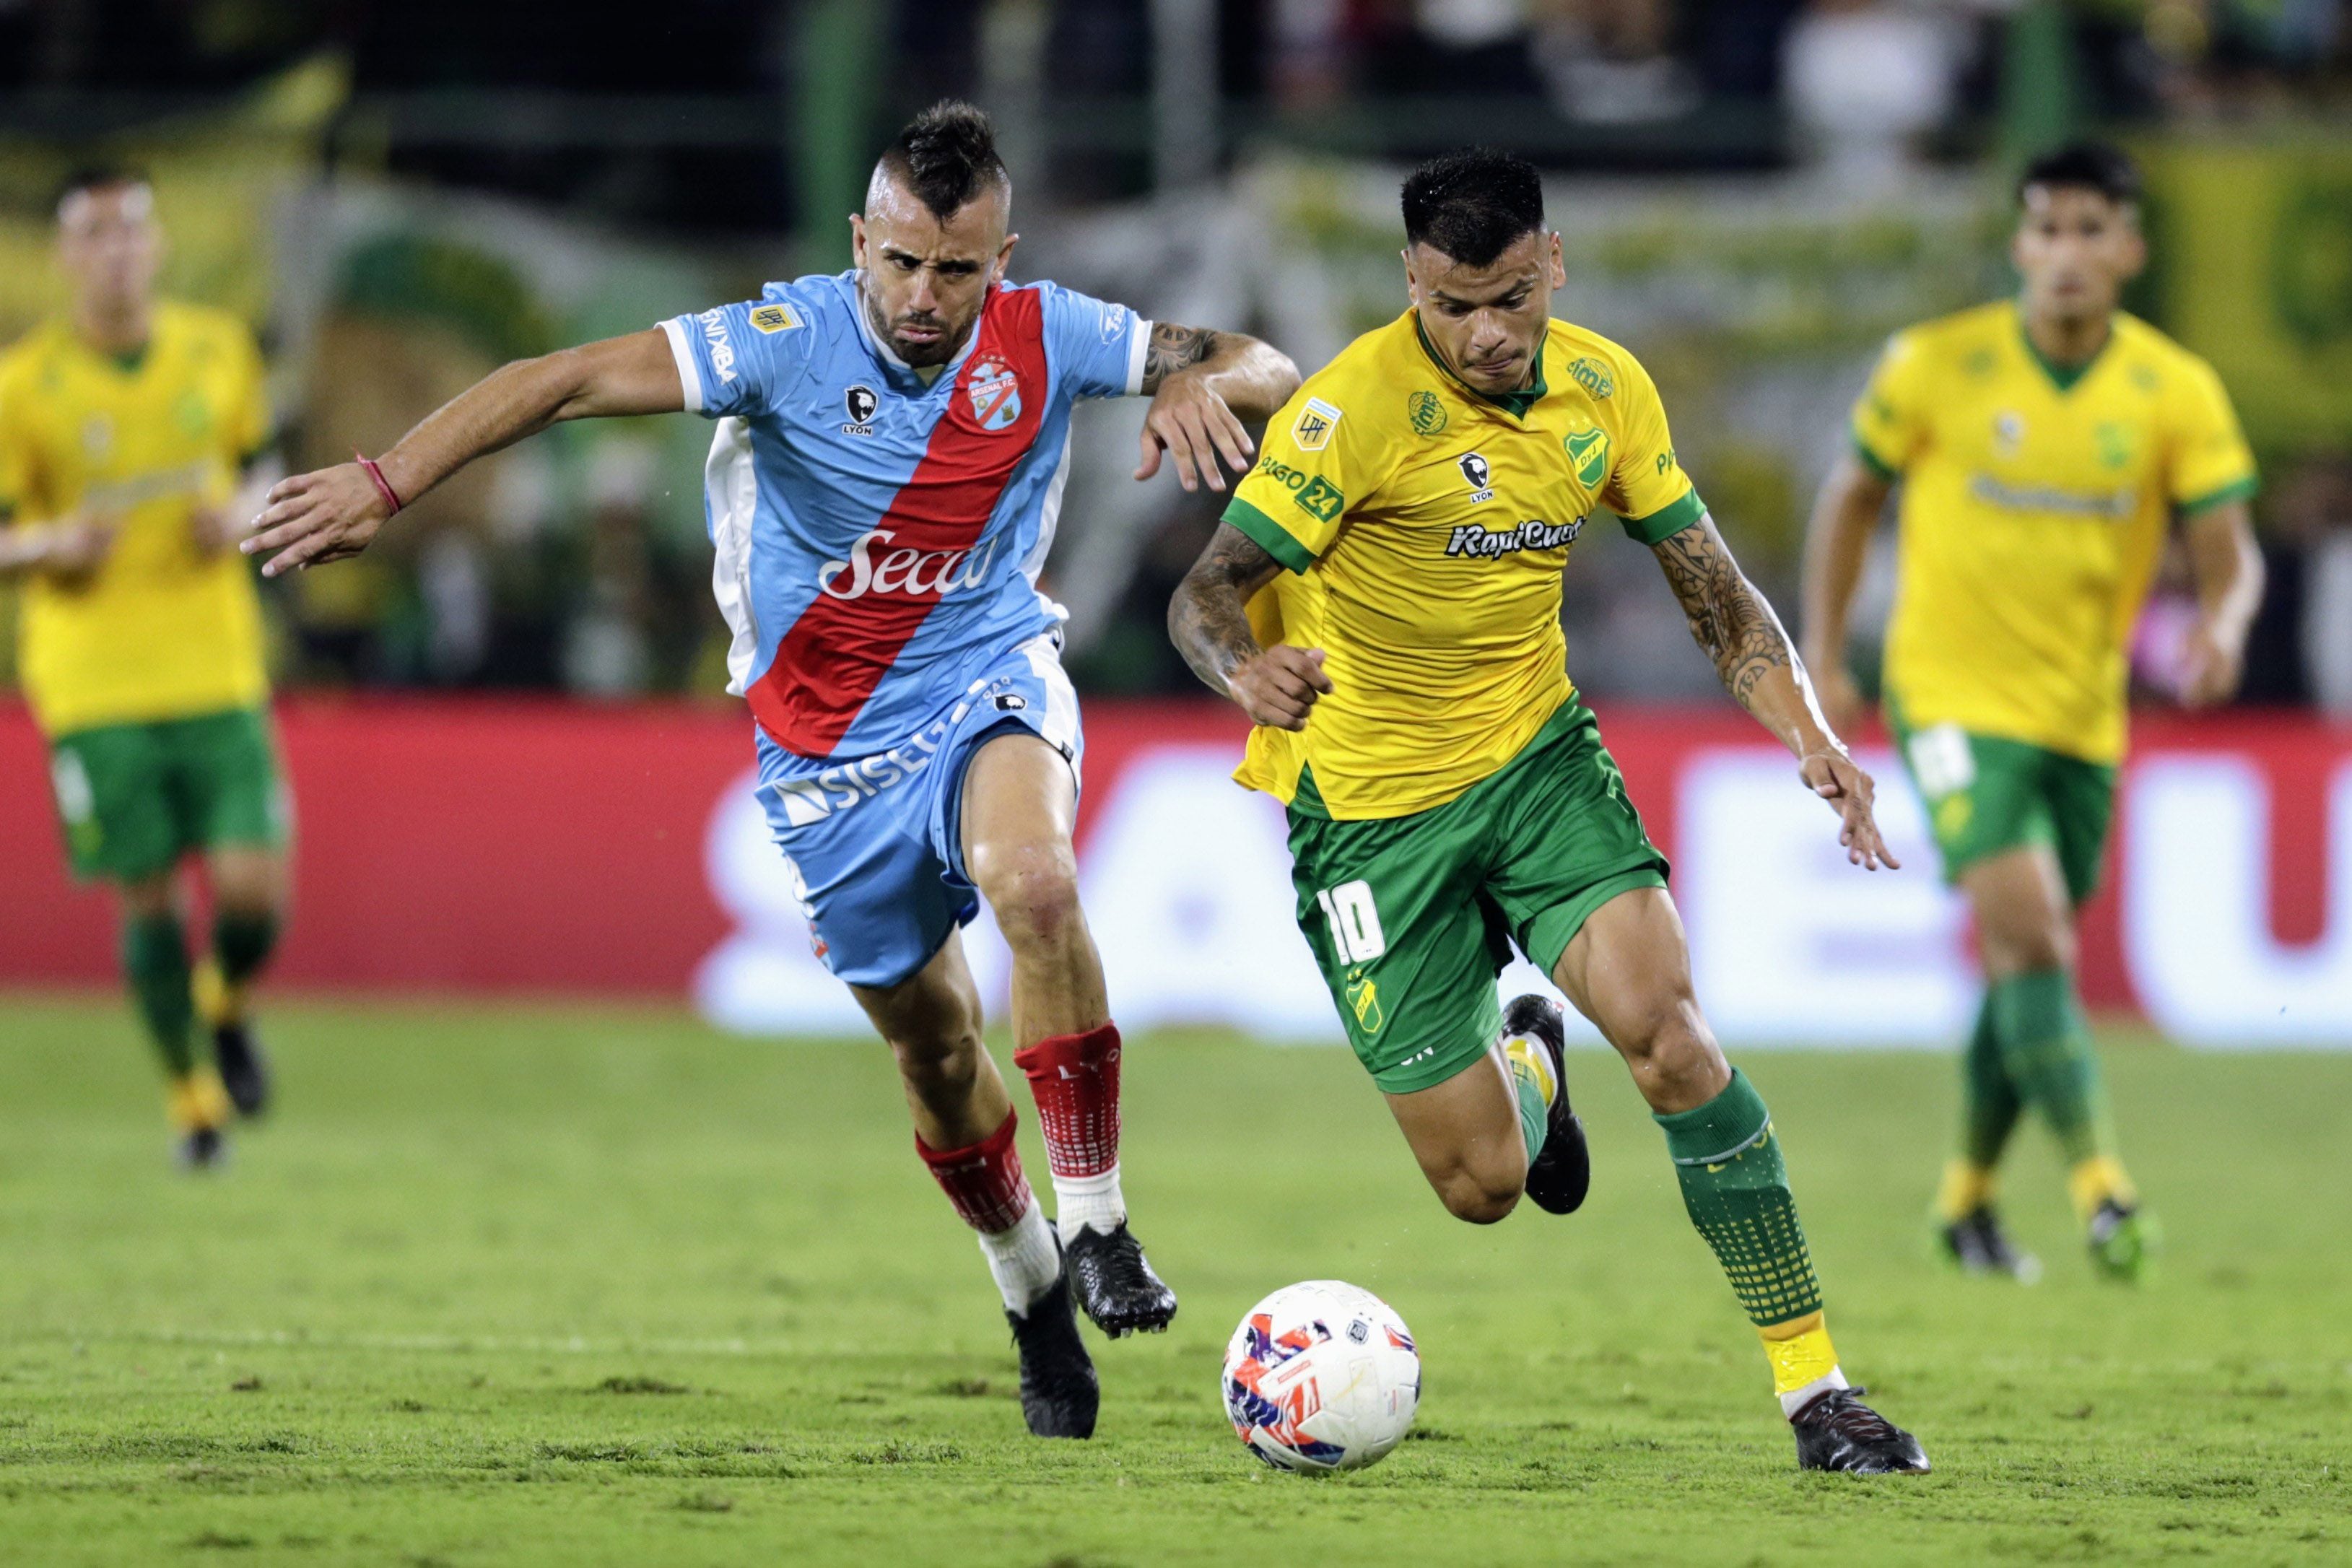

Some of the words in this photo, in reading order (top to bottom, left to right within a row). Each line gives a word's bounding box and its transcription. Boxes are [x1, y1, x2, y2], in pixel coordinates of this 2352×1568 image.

[970, 382, 1003, 398] ARSENAL
[843, 426, 872, 435] LYON
[1305, 485, 1338, 515] 24
[1471, 491, 1493, 503] LYON
[1317, 879, 1386, 965] 10
